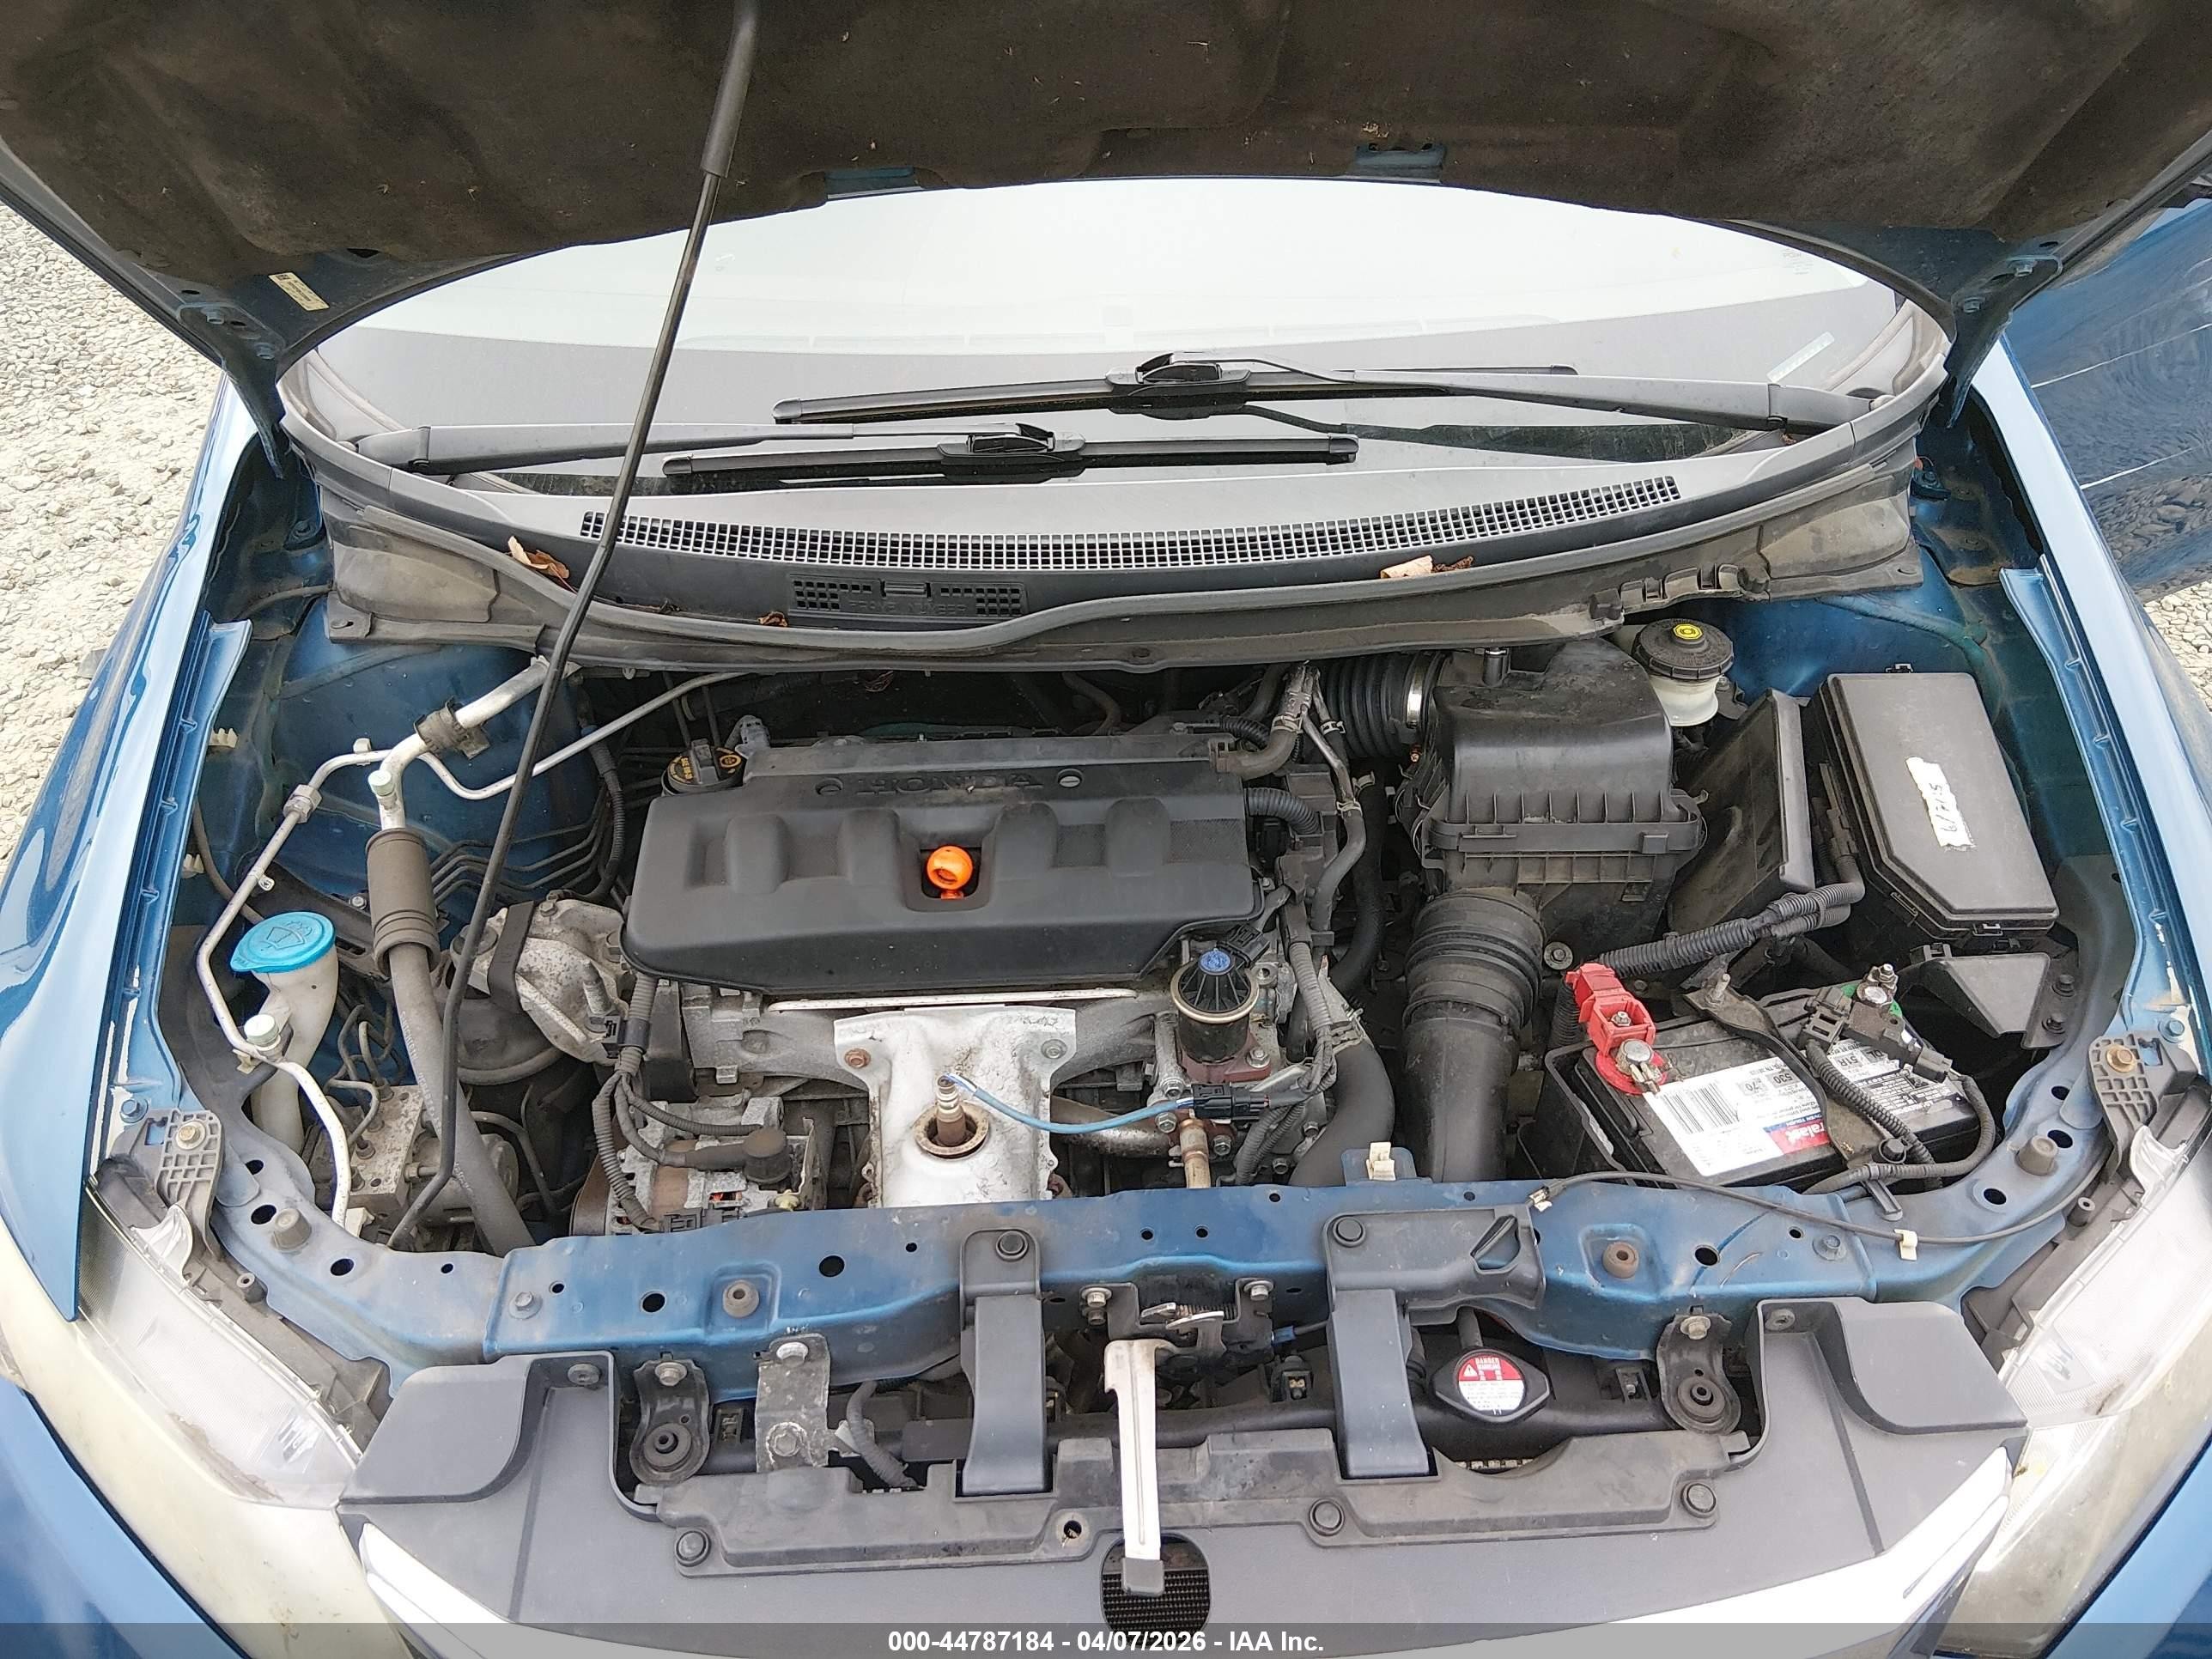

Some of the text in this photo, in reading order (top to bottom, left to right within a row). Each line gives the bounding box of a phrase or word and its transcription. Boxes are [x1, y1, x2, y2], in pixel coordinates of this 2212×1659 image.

[908, 602, 968, 614] NUMBER
[856, 775, 1044, 796] HONDA
[1838, 1055, 1858, 1066] 51R
[1773, 1073, 1793, 1084] 530
